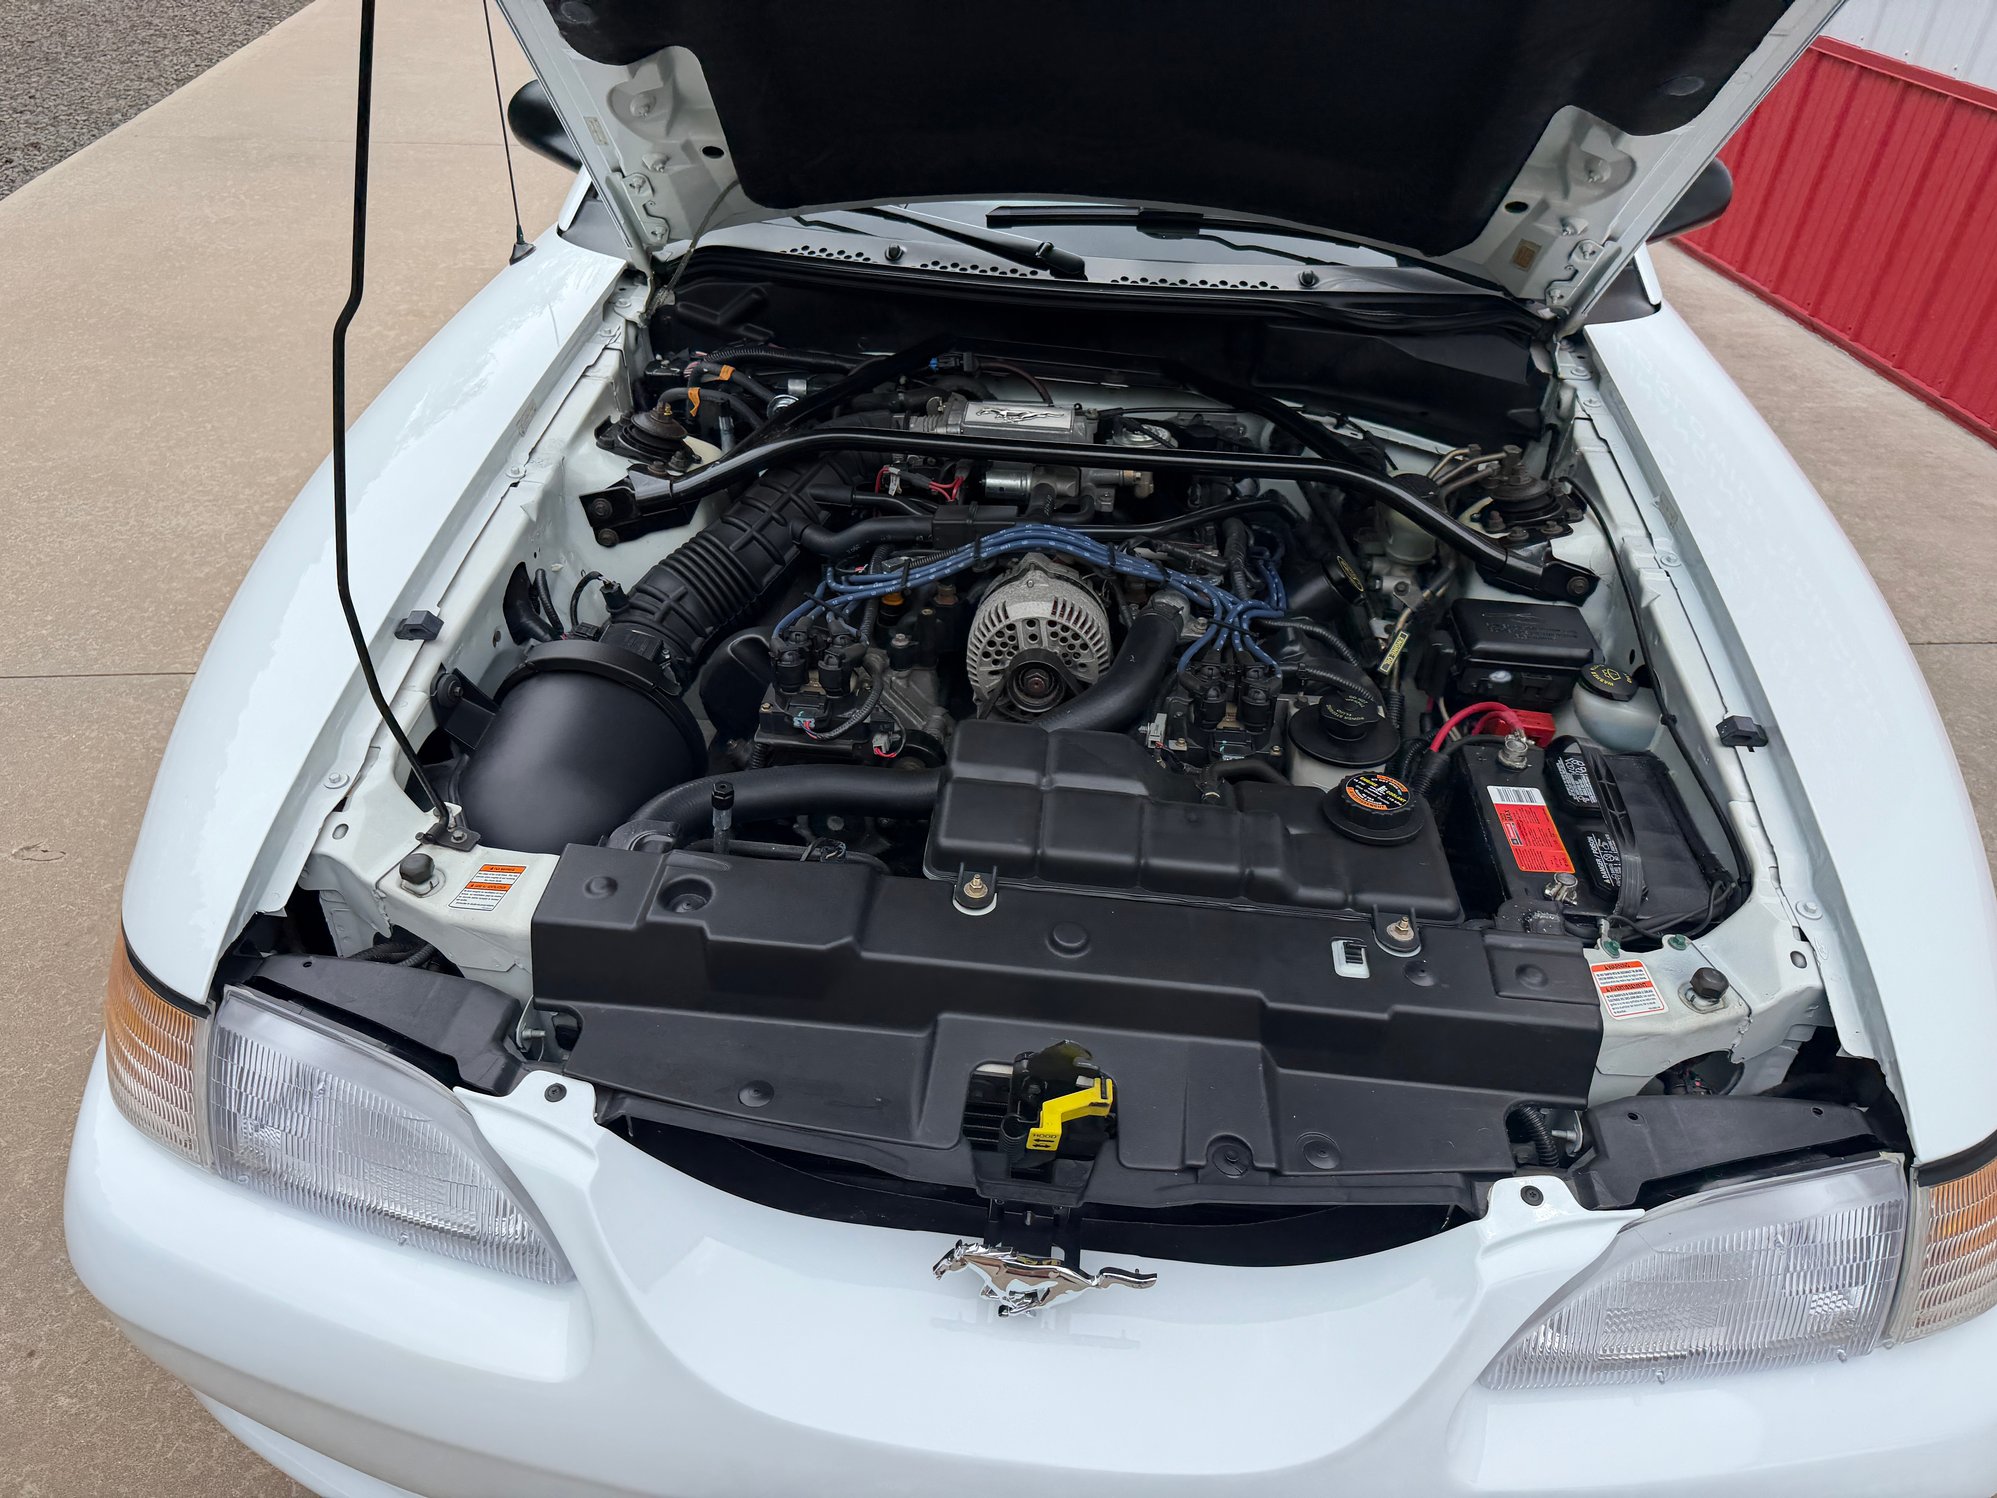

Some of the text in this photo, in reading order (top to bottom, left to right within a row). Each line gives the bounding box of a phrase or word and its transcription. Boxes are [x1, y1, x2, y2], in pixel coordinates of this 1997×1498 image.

[1384, 636, 1405, 666] ENGINE OIL
[1359, 776, 1378, 787] ENGINE
[1385, 790, 1407, 802] COOLANT
[1587, 836, 1600, 854] POISON
[1596, 858, 1610, 878] DANGER
